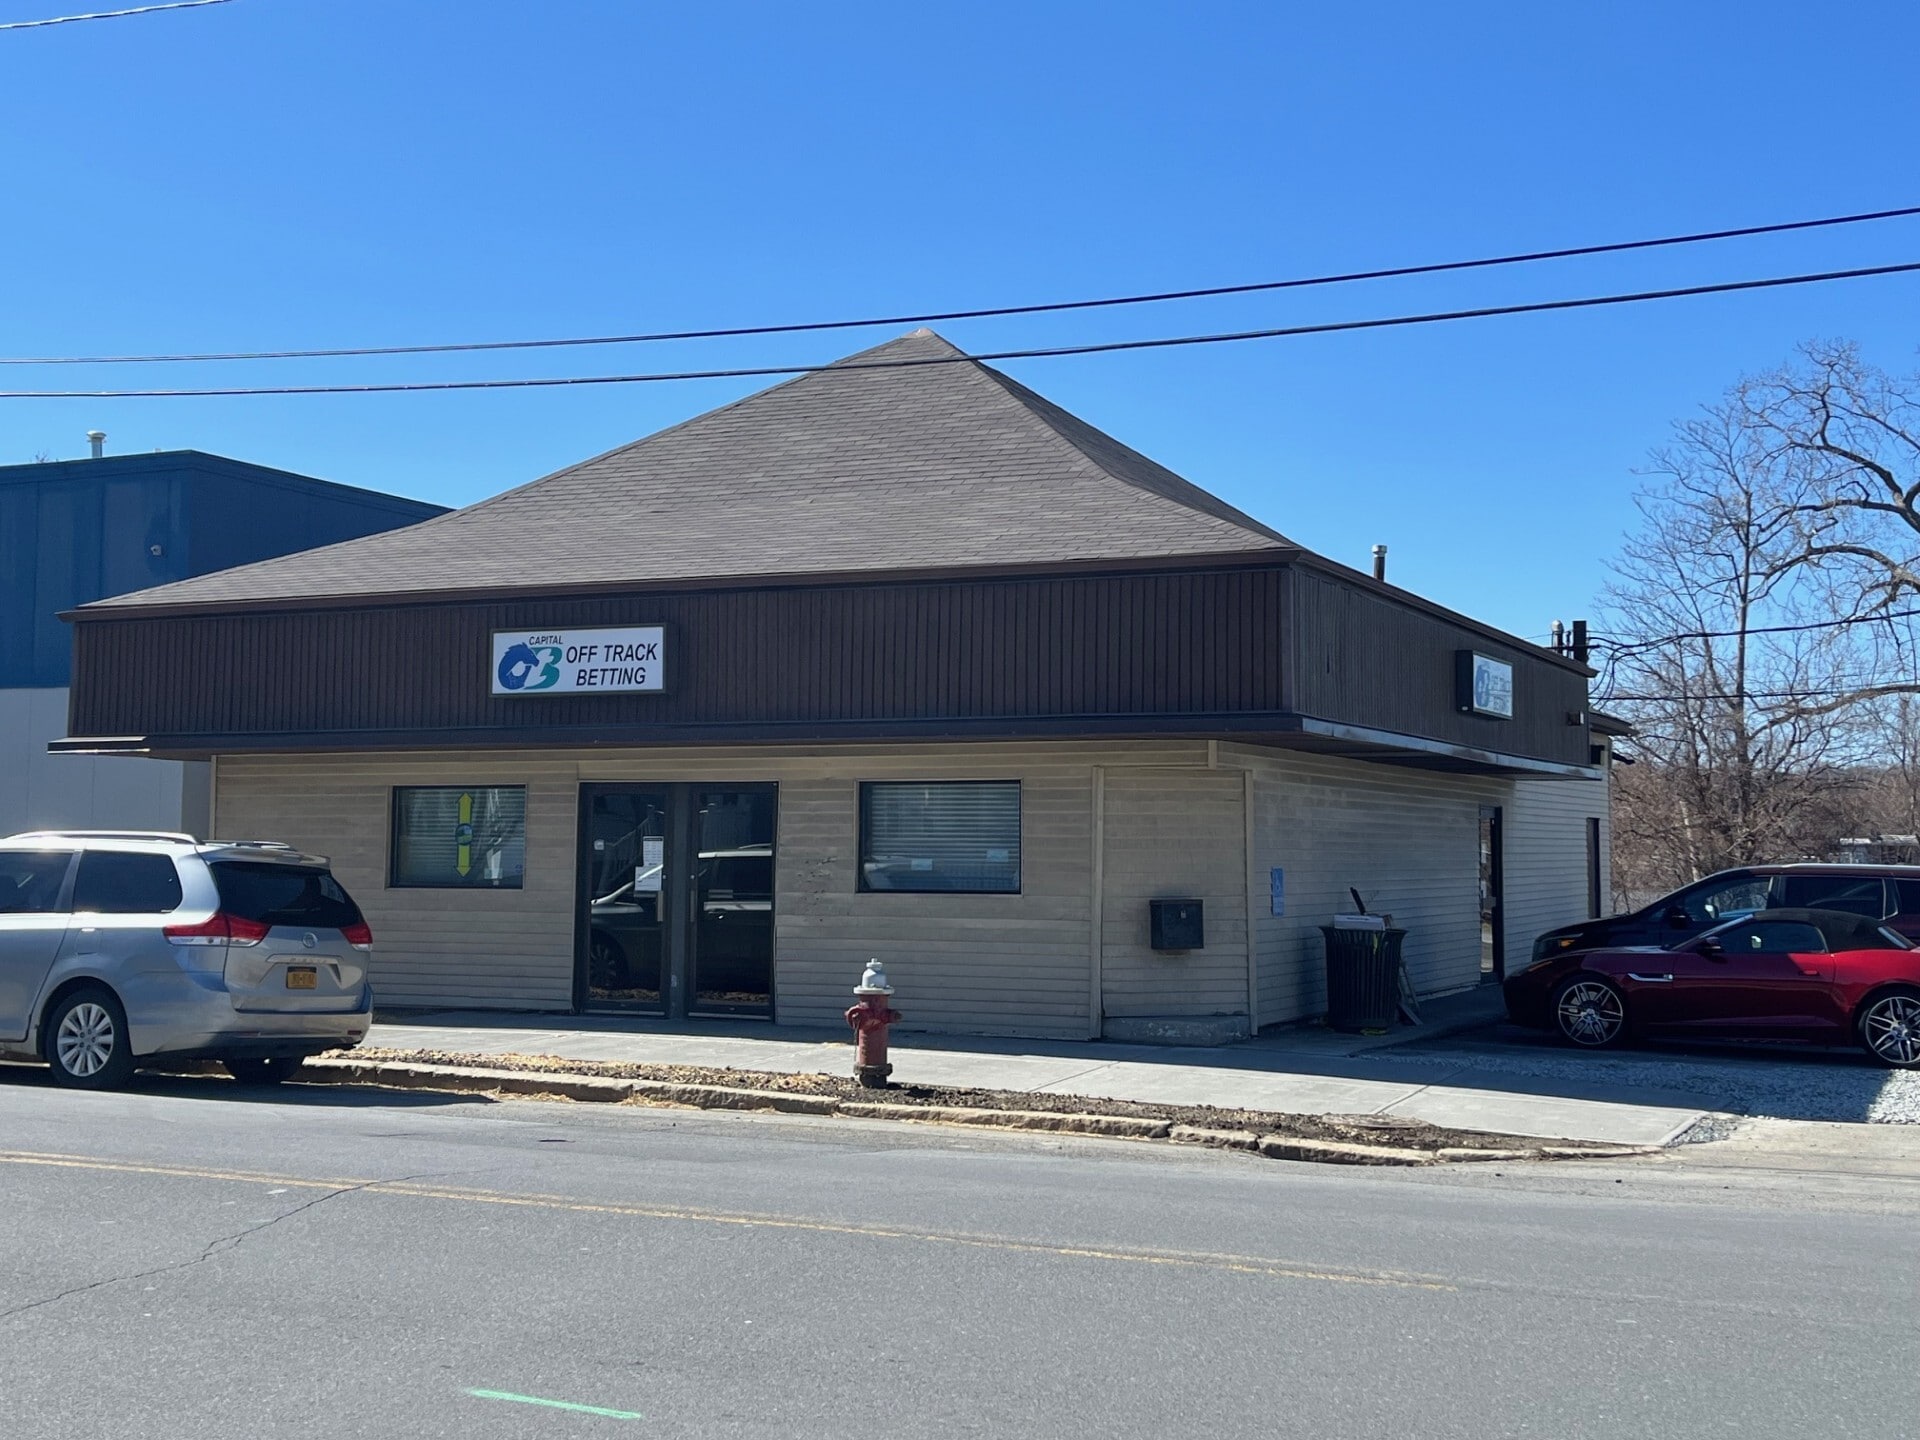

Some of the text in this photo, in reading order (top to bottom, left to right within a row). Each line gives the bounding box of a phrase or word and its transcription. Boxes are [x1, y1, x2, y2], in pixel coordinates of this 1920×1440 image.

[529, 635, 563, 645] CAPITAL
[566, 643, 658, 663] OFF TRACK
[576, 667, 646, 686] BETTING
